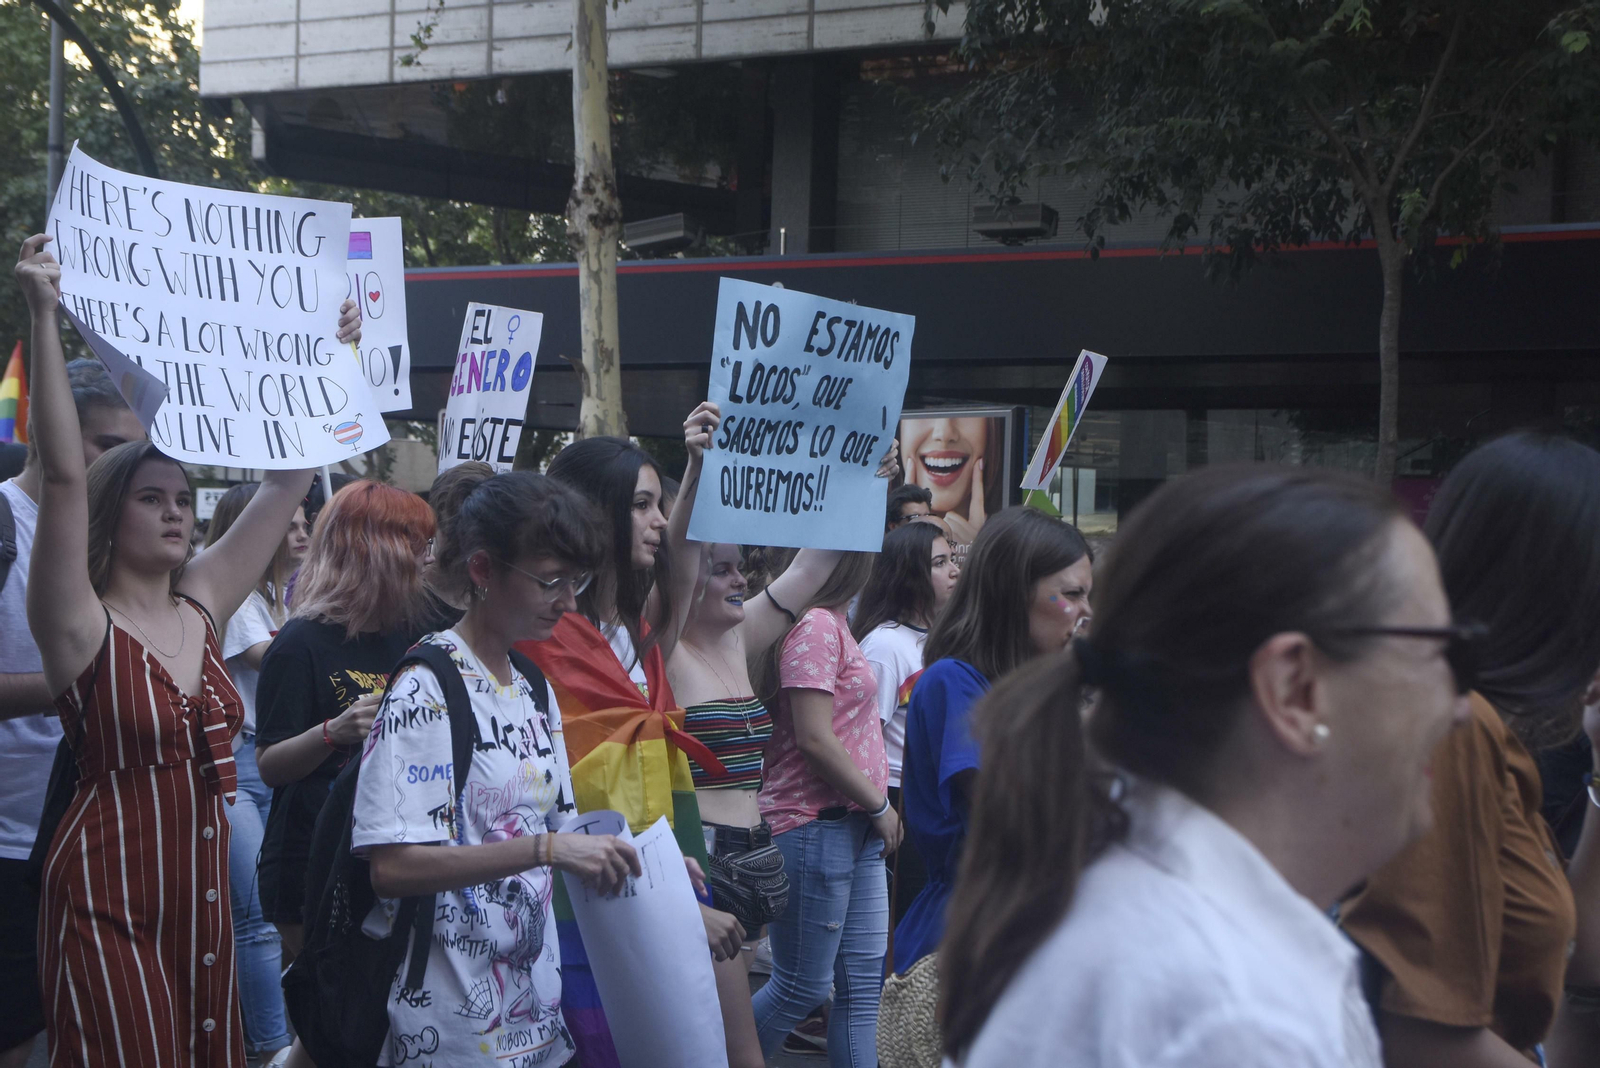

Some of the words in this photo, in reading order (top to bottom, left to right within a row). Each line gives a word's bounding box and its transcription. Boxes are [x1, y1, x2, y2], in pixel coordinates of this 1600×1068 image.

[184, 198, 326, 258] NOTHING
[55, 218, 151, 287] WRONG
[151, 246, 240, 303] WITH
[247, 259, 319, 313] YOU
[61, 291, 150, 343] THERE'S
[157, 310, 175, 348] A
[181, 316, 226, 357] LOT
[233, 325, 335, 367] WRONG
[470, 308, 492, 345] EL
[732, 300, 781, 351] NO
[803, 310, 900, 371] ESTAMOS
[155, 359, 215, 408] THE
[219, 367, 349, 418] WORLD
[812, 374, 853, 411] QUE
[179, 412, 240, 458] LIVE
[263, 419, 305, 460] IN
[440, 416, 455, 461] NO
[717, 415, 804, 458] SABEMOS
[809, 424, 836, 459] LO
[720, 464, 831, 516] QUEREMOS!!
[436, 903, 458, 924] IS
[460, 905, 491, 931] STILL
[496, 1028, 533, 1052] NOBODY
